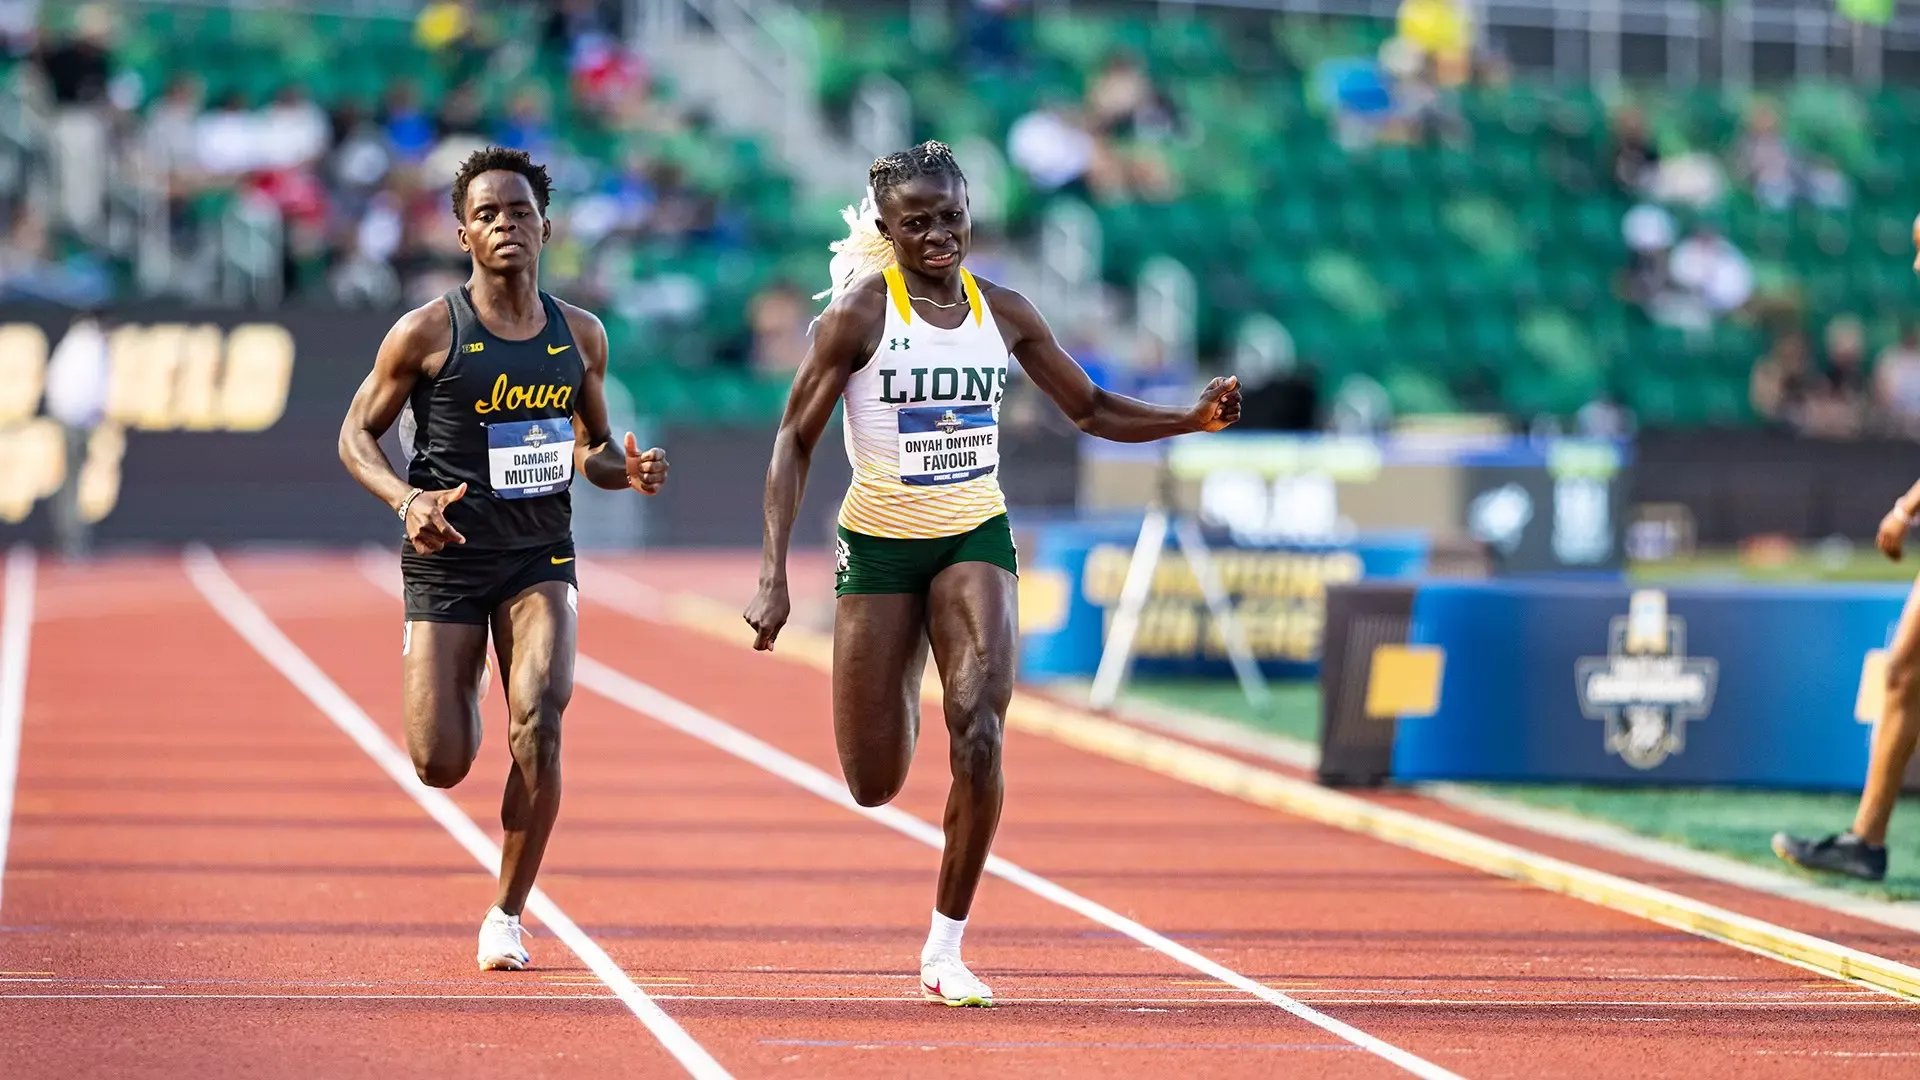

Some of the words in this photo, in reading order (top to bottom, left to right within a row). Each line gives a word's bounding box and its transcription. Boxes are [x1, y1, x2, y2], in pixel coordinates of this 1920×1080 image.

[474, 373, 572, 414] Iowa
[879, 367, 1006, 403] LIONS
[905, 439, 942, 453] ONYAH
[946, 434, 993, 450] ONYINYE
[513, 451, 558, 466] DAMARIS
[923, 451, 977, 471] FAVOUR
[505, 464, 564, 485] MUTUNGA
